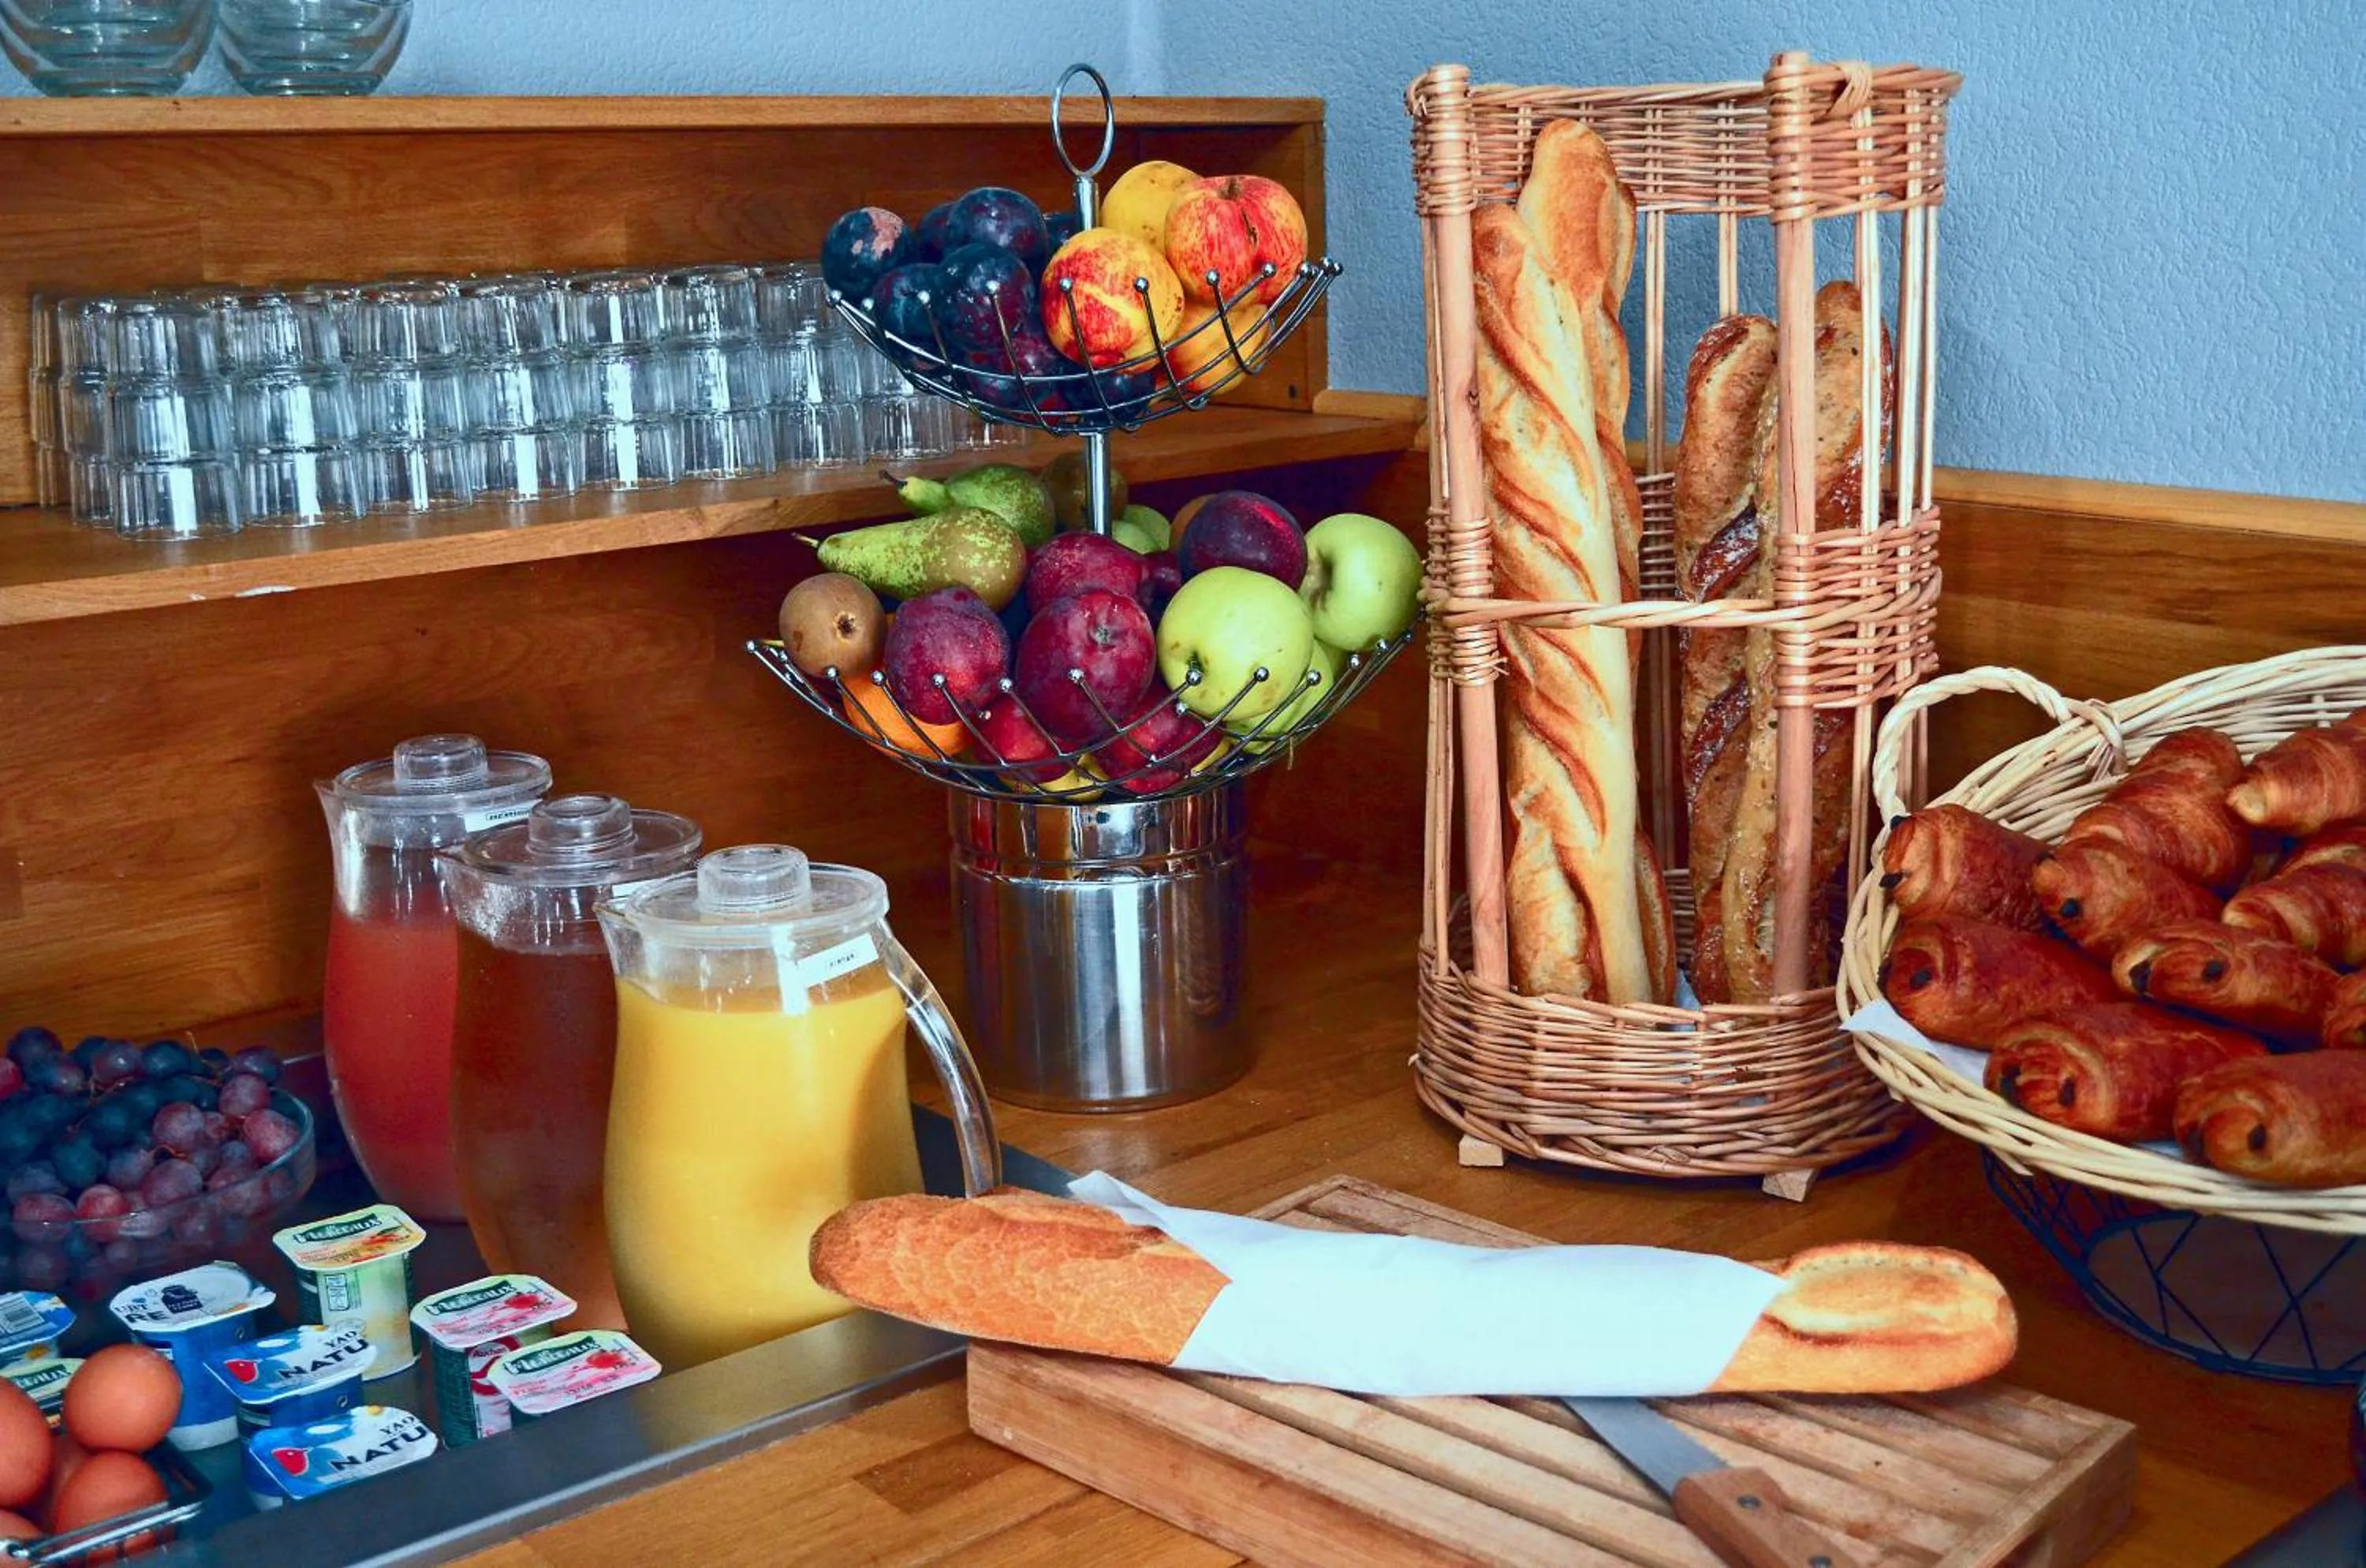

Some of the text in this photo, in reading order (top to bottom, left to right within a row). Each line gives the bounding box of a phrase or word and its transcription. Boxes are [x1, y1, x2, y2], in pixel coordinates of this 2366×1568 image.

[125, 1310, 167, 1323] RE
[278, 1339, 369, 1379] NATU
[330, 1425, 427, 1471] NATU
